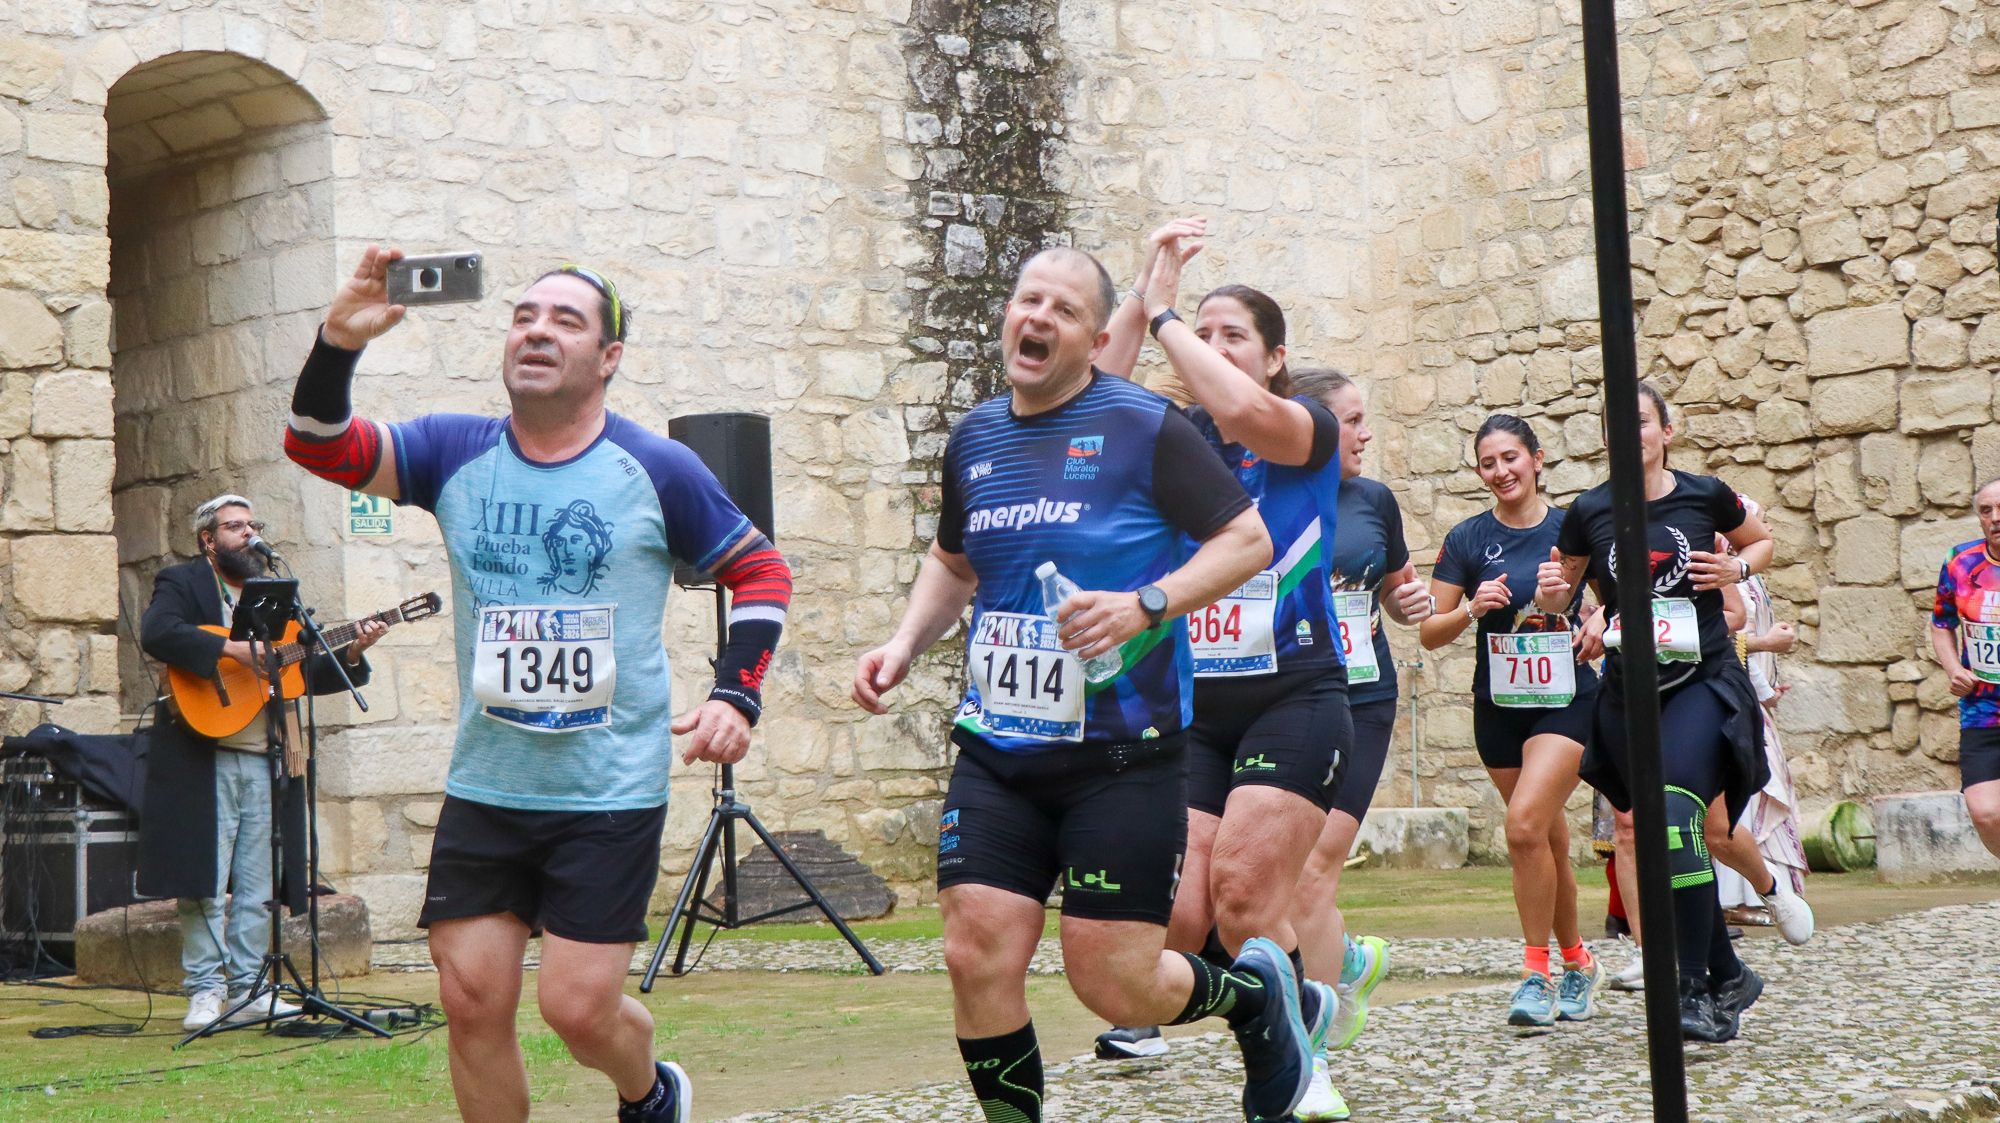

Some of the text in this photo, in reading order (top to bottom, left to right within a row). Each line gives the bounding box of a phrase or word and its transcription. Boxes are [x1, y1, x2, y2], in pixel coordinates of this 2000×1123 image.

[1066, 457, 1086, 465] Club
[1063, 472, 1096, 480] Lucena
[354, 519, 388, 529] SALIDA
[470, 498, 542, 536] XIII
[474, 535, 530, 555] Prueba
[471, 553, 529, 576] Fondo
[468, 576, 518, 597] VILLA
[497, 611, 540, 640] 21K
[1189, 604, 1242, 643] 564
[1658, 619, 1672, 643] 2
[1339, 621, 1352, 655] 3
[496, 646, 594, 694] 1349
[983, 651, 1064, 702] 1414
[1506, 656, 1552, 684] 710
